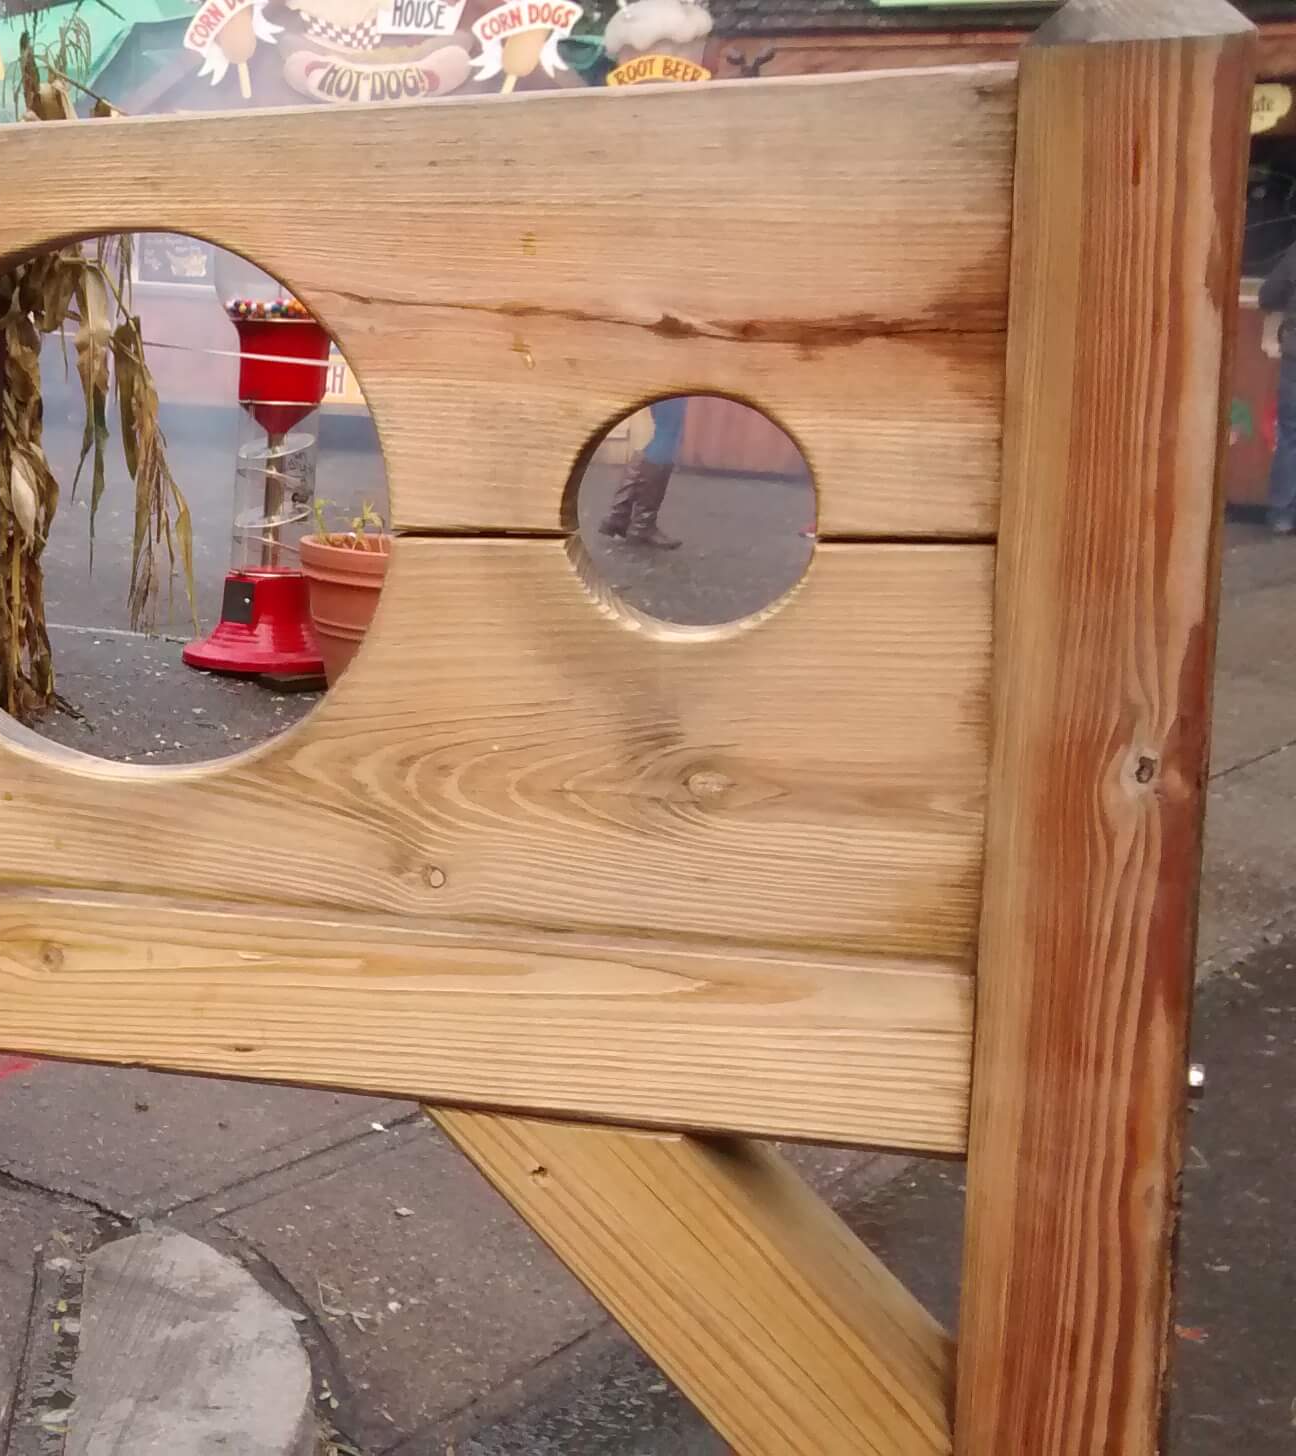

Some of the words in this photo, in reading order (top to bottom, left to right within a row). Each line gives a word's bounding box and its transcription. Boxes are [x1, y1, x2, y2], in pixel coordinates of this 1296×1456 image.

[189, 2, 225, 48] CORN
[392, 0, 446, 29] HOUSE
[480, 6, 523, 40] CORN
[527, 3, 576, 28] DOGS
[614, 58, 656, 86] ROOT
[662, 58, 702, 81] BEER
